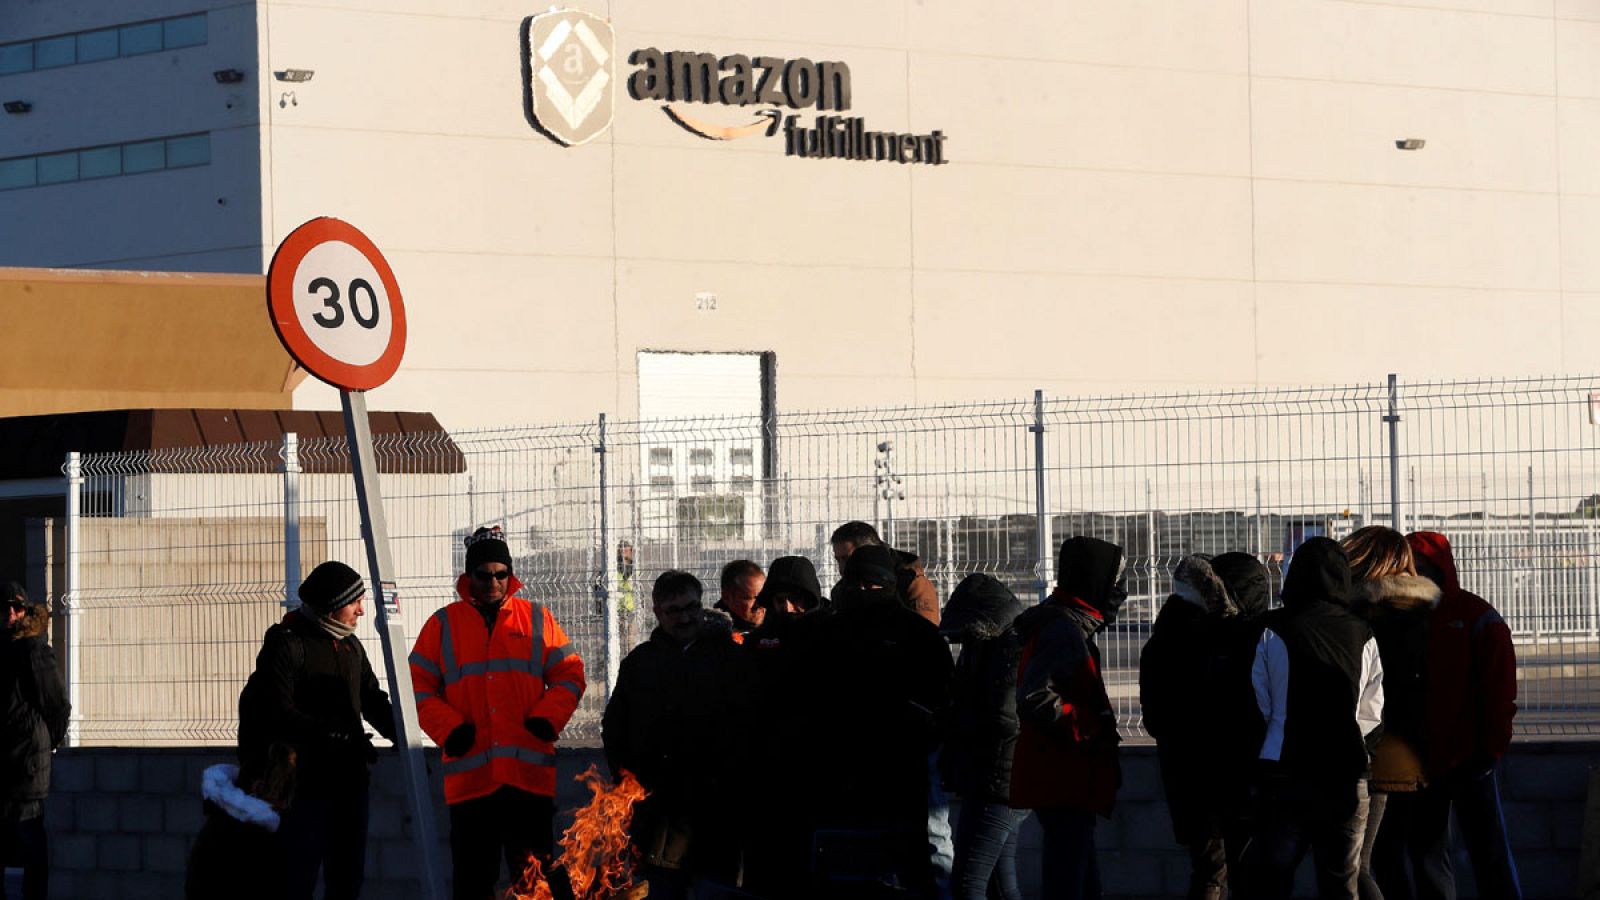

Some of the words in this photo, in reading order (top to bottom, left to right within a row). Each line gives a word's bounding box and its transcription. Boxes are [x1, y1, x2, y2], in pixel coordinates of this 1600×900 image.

[564, 43, 583, 74] a
[627, 46, 851, 111] amazon
[784, 115, 949, 165] fulfillment
[308, 277, 379, 329] 30
